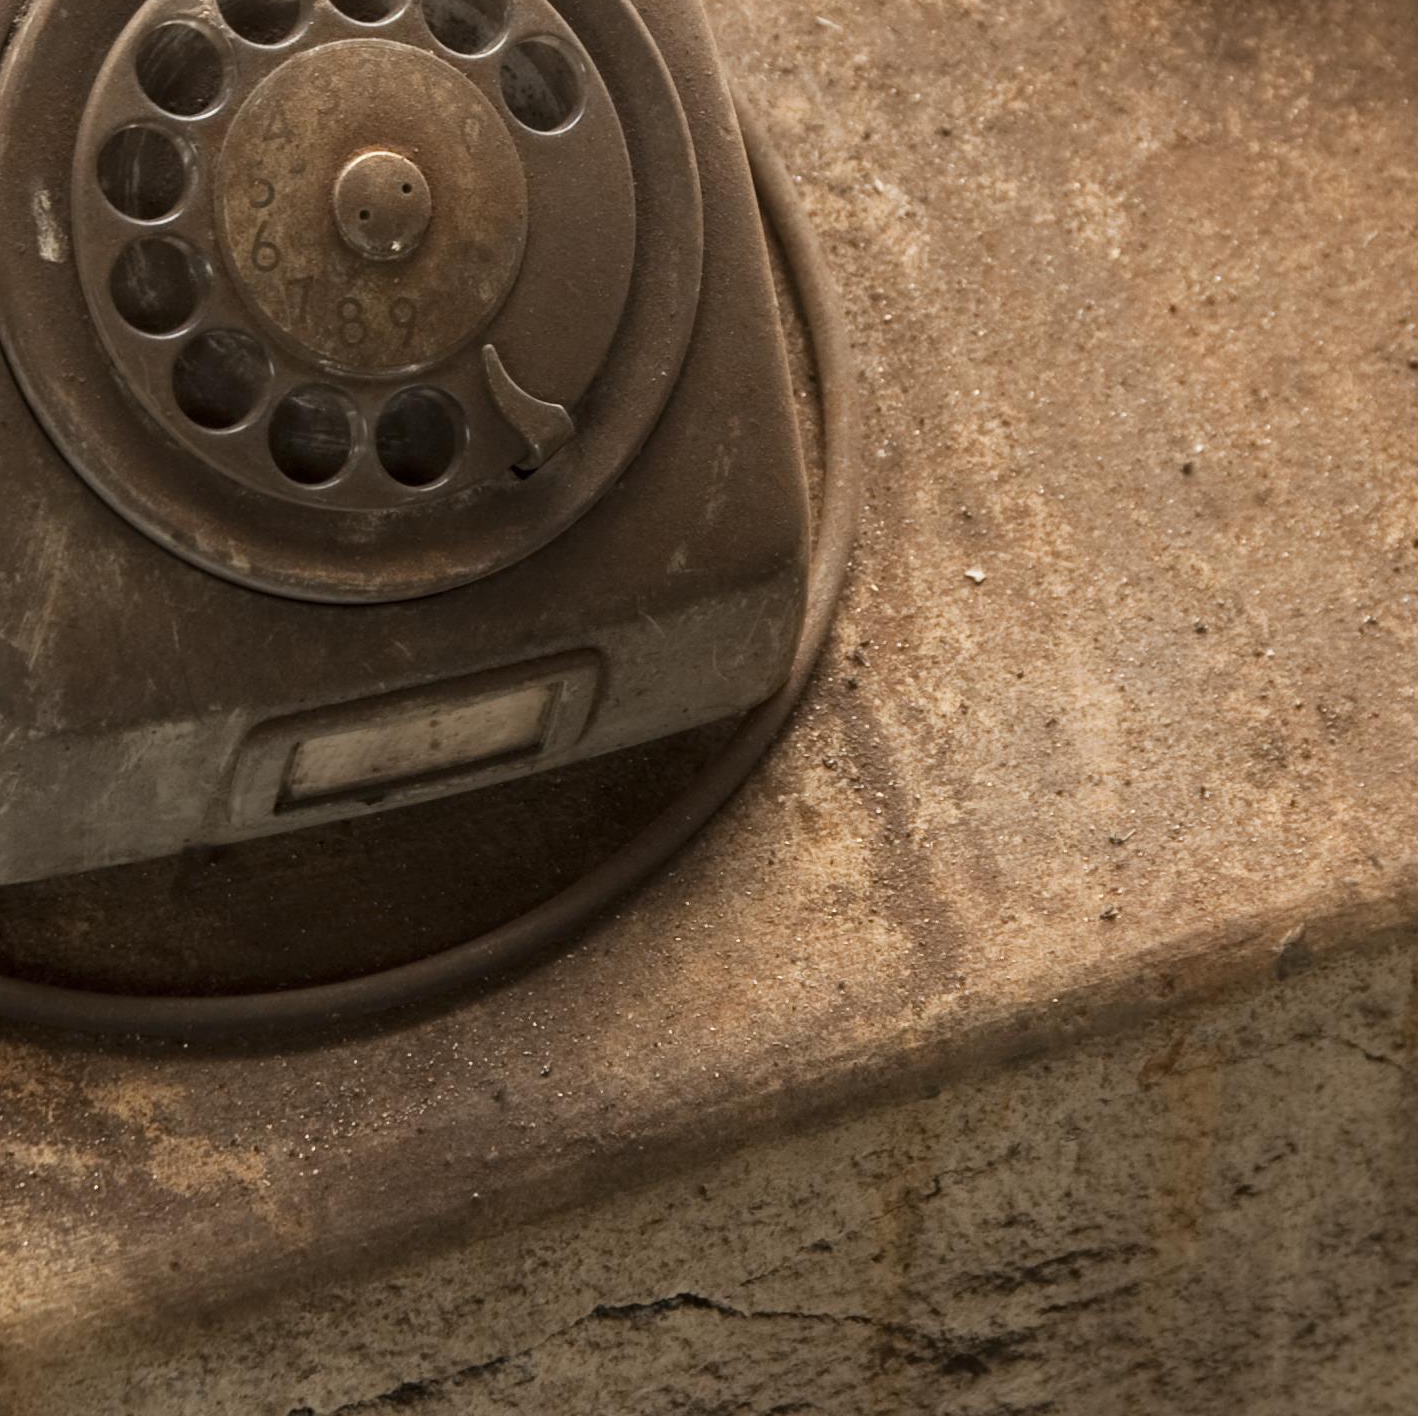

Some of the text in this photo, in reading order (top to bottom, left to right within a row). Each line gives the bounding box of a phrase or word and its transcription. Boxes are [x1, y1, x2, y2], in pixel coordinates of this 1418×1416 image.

[251, 220, 281, 272] 6
[286, 276, 315, 322] 7
[337, 296, 366, 345] 8
[389, 297, 416, 348] 9
